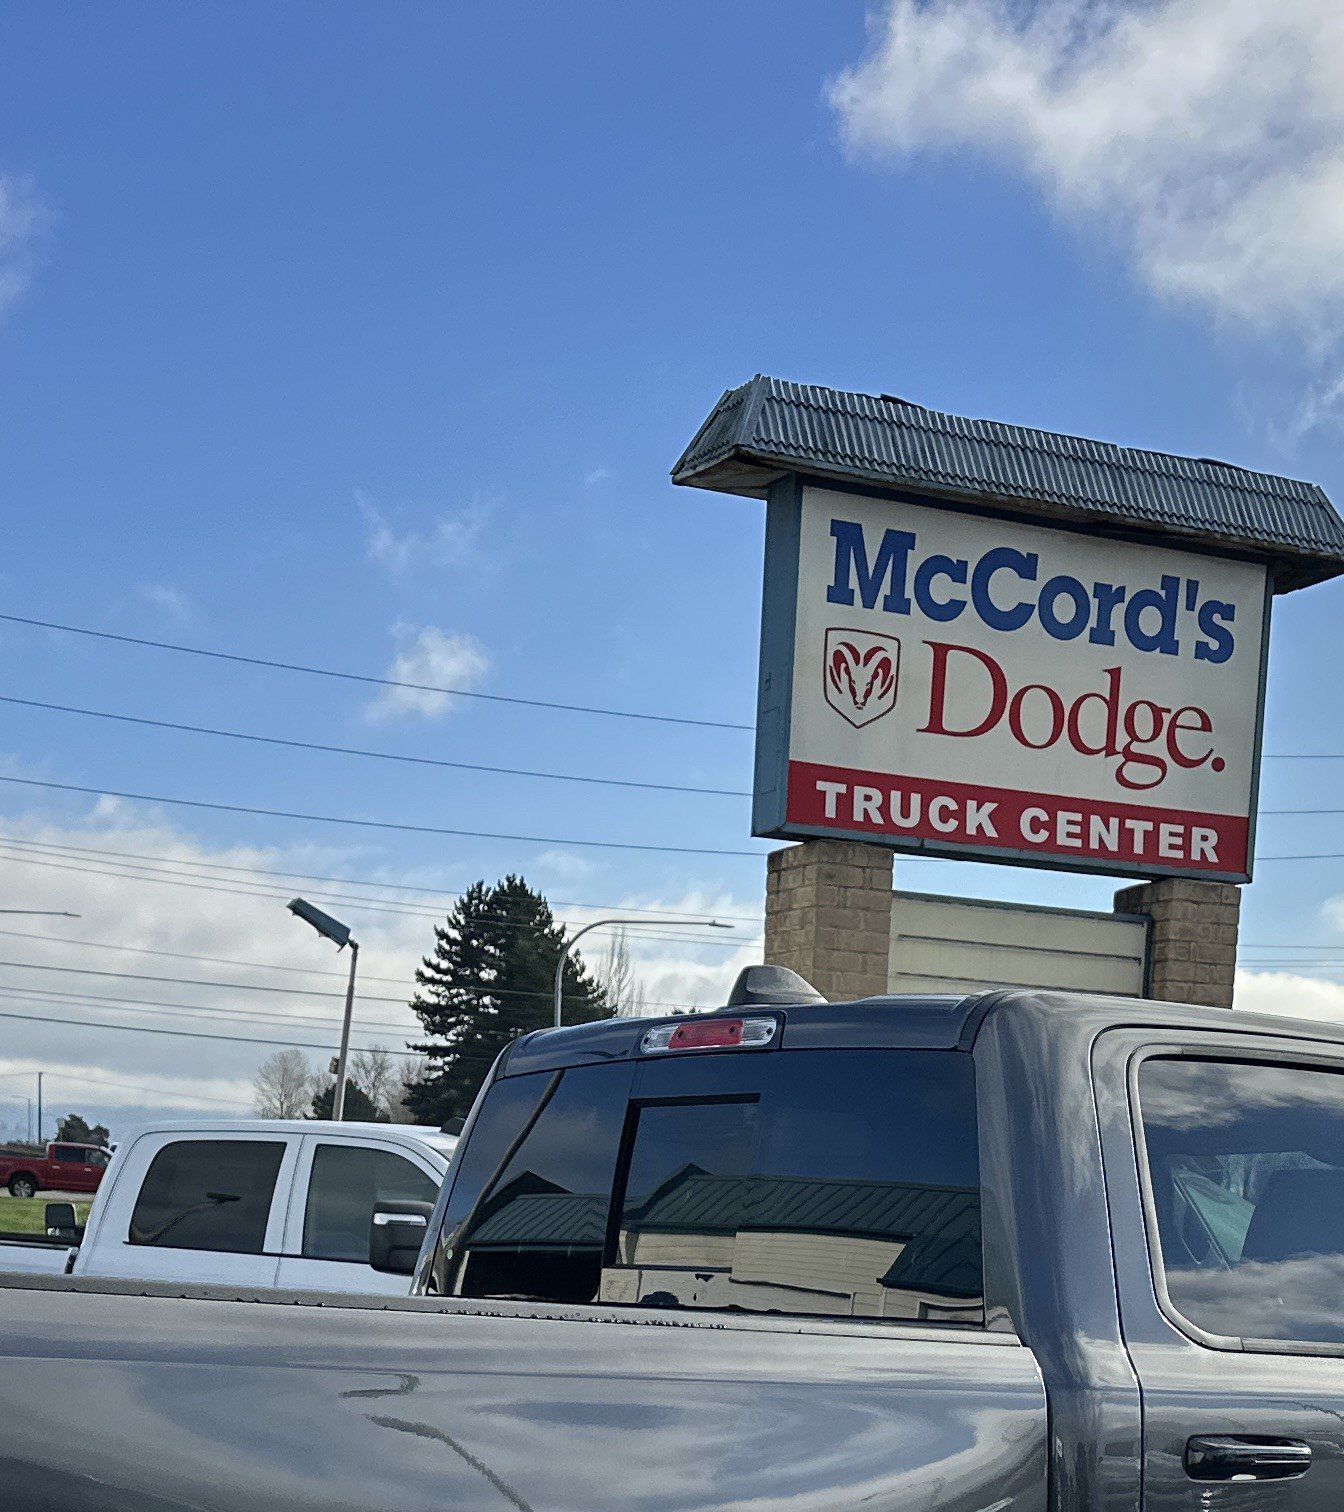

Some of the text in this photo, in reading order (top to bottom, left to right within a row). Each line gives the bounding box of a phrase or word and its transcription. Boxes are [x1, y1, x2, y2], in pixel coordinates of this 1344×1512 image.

[826, 519, 1236, 664] McCord's
[816, 780, 1220, 863] TRUCK CENTER
